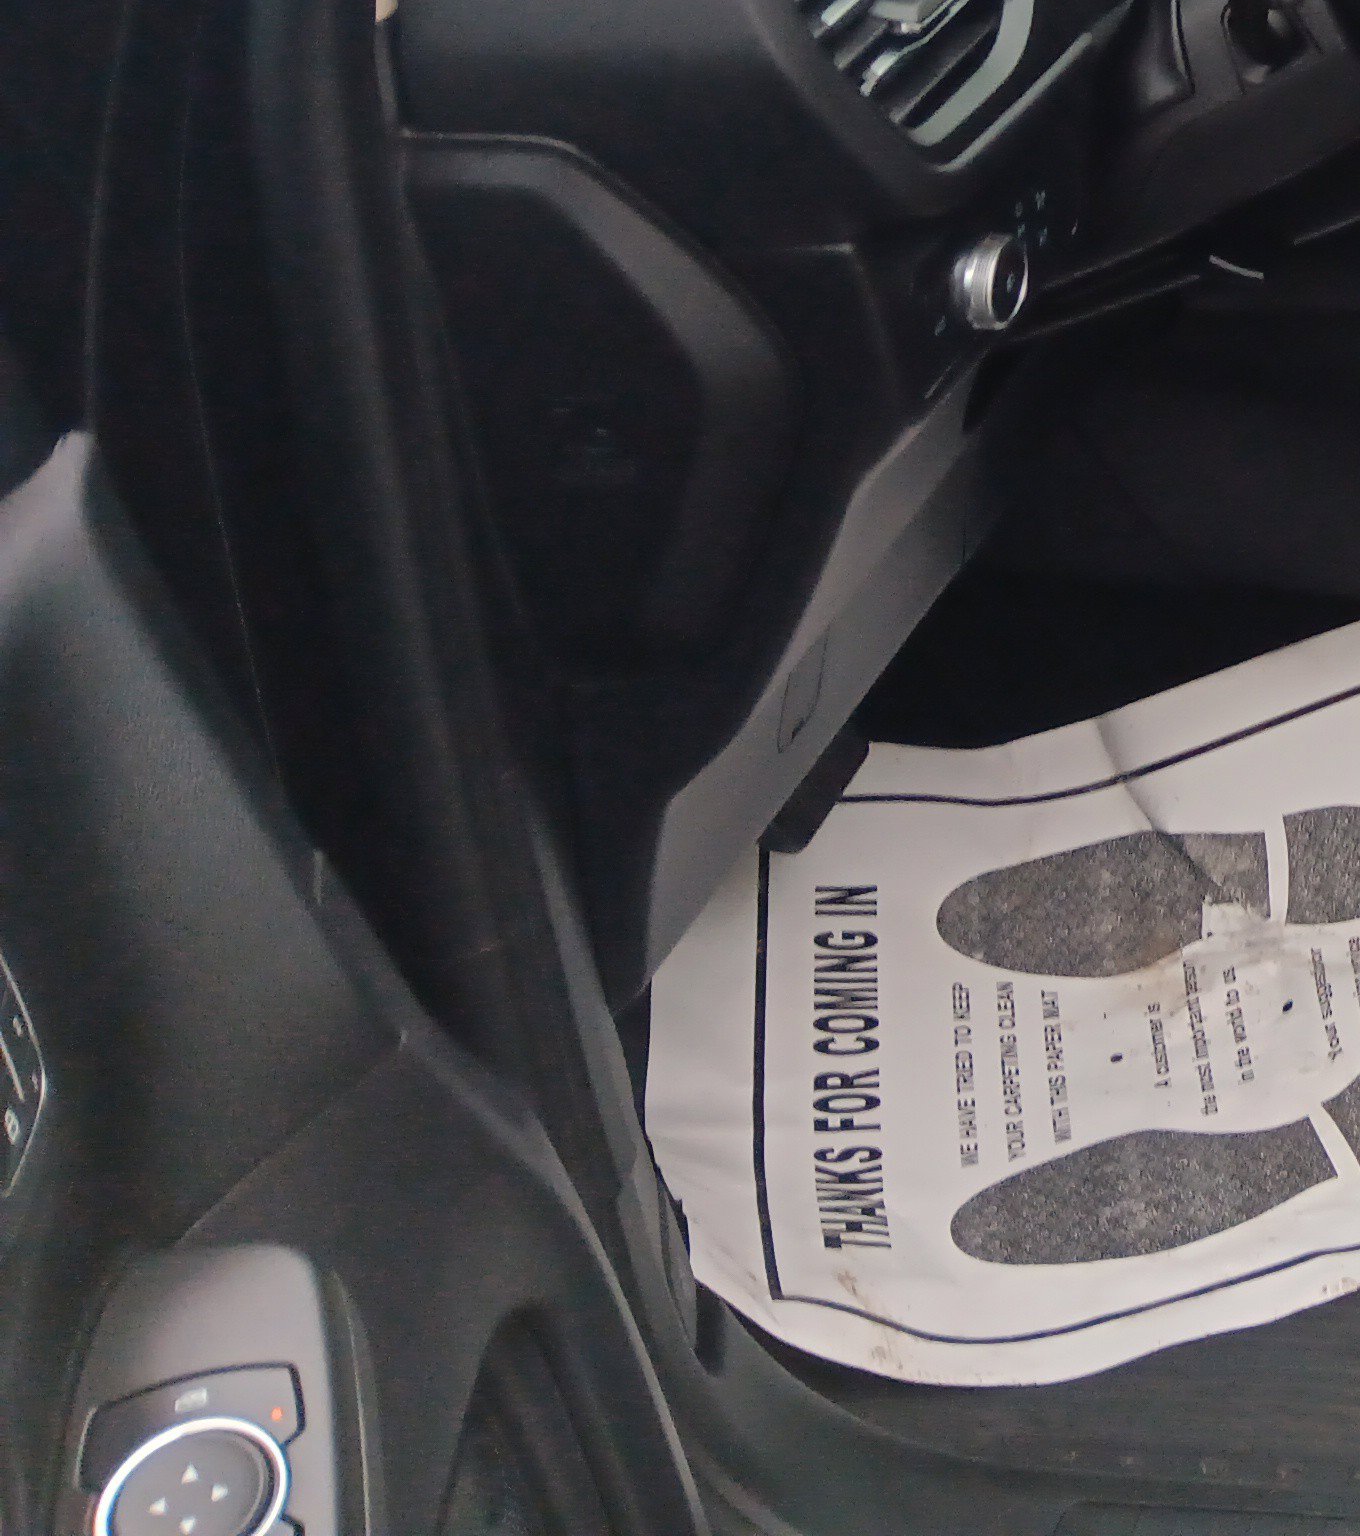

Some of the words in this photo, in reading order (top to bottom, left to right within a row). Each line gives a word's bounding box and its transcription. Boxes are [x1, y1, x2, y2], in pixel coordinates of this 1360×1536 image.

[814, 885, 877, 918] IN
[812, 931, 879, 1055] COMING
[952, 982, 970, 1021] KEEP
[997, 981, 1015, 1029] CLEAN
[1041, 990, 1059, 1019] MAT
[954, 1025, 972, 1047] TO
[1044, 1024, 1064, 1071] PAPER
[955, 1050, 974, 1094] TRIED
[999, 1034, 1022, 1116] CARPETING
[1048, 1075, 1067, 1106] THIS
[812, 1068, 880, 1133] FOR
[957, 1098, 976, 1139] HAVE
[960, 1143, 978, 1167] WE
[1006, 1120, 1025, 1162] YOUR
[813, 1146, 891, 1249] THANKS
